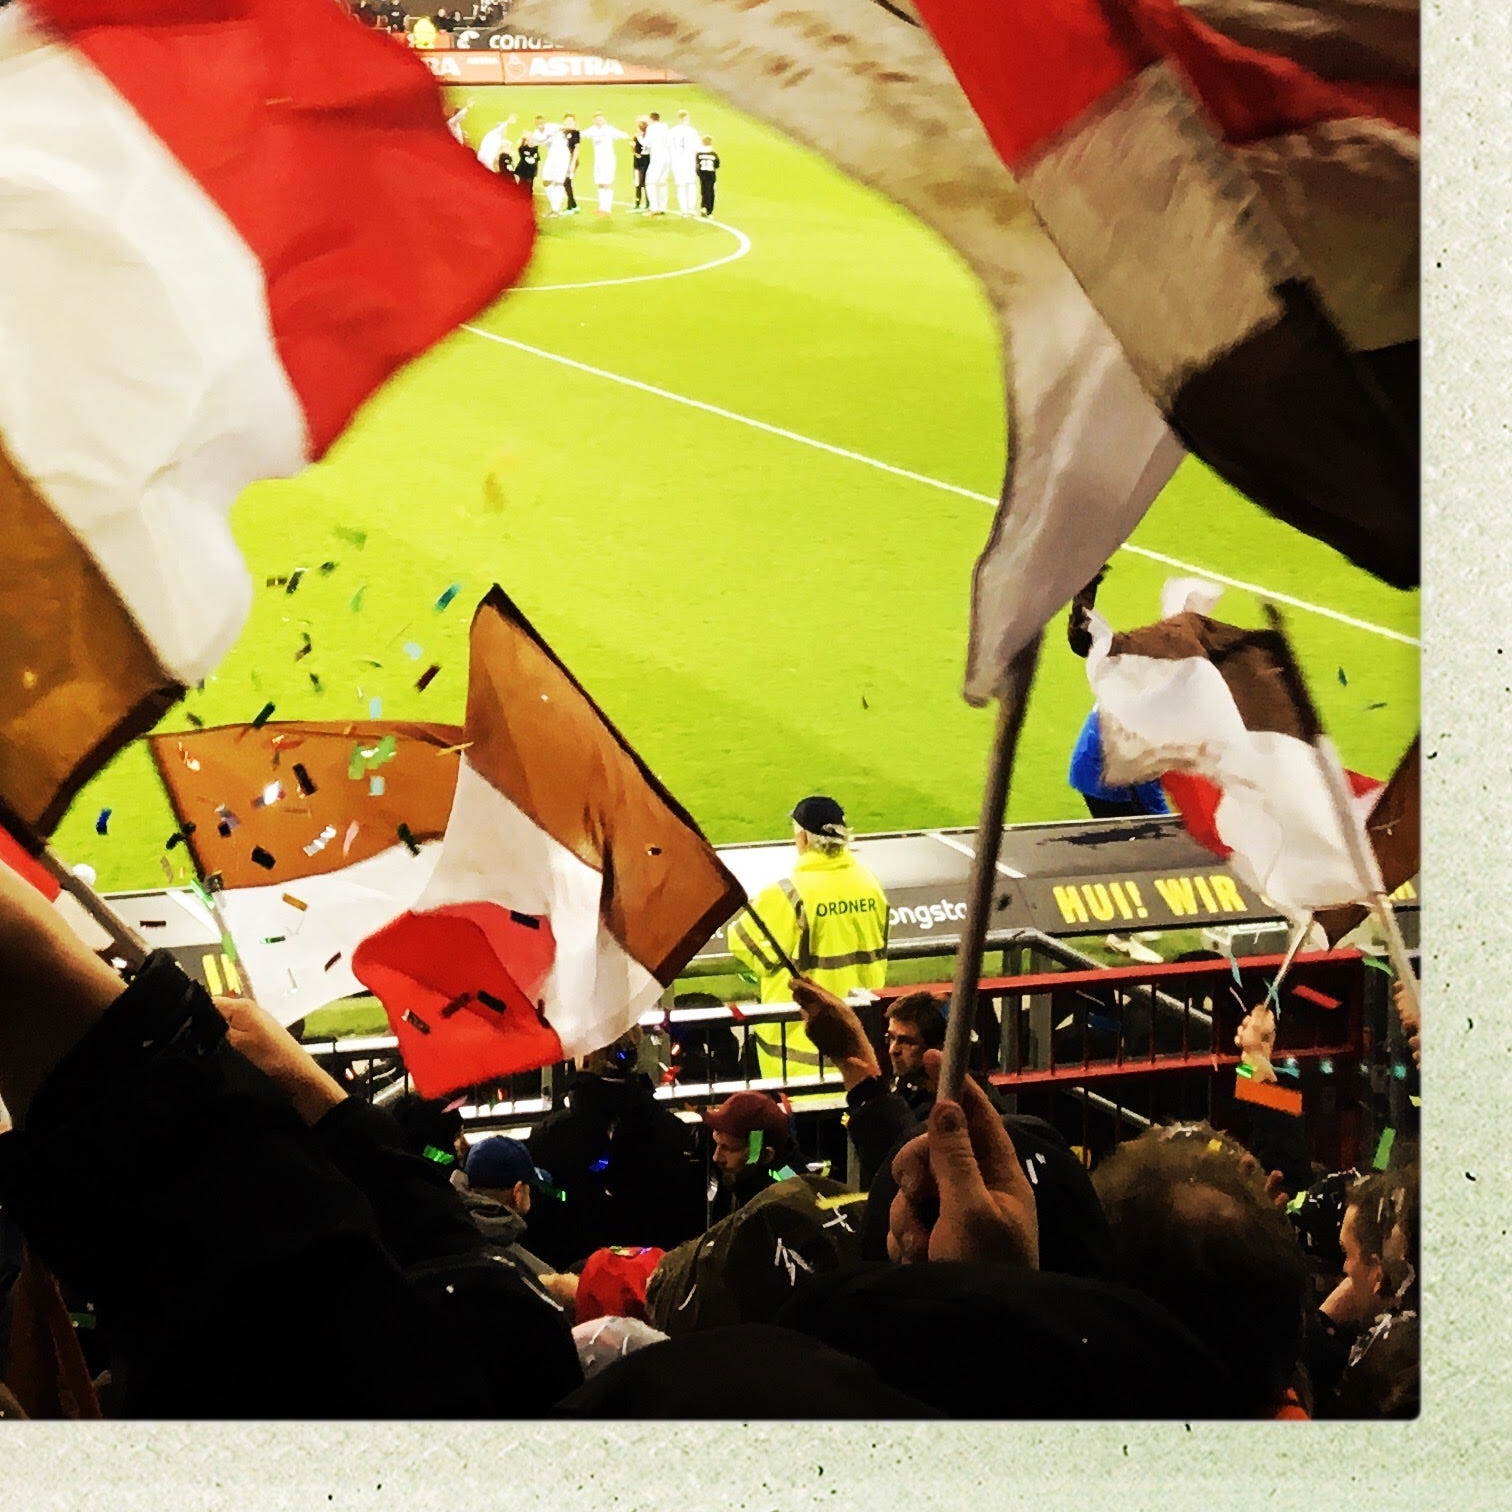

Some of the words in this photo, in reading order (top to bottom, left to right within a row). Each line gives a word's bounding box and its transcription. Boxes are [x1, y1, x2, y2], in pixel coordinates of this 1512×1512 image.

[529, 55, 625, 77] ASTRA
[815, 897, 877, 918] ORDNER
[1052, 880, 1149, 924] HUI!
[1153, 874, 1248, 917] WIR
